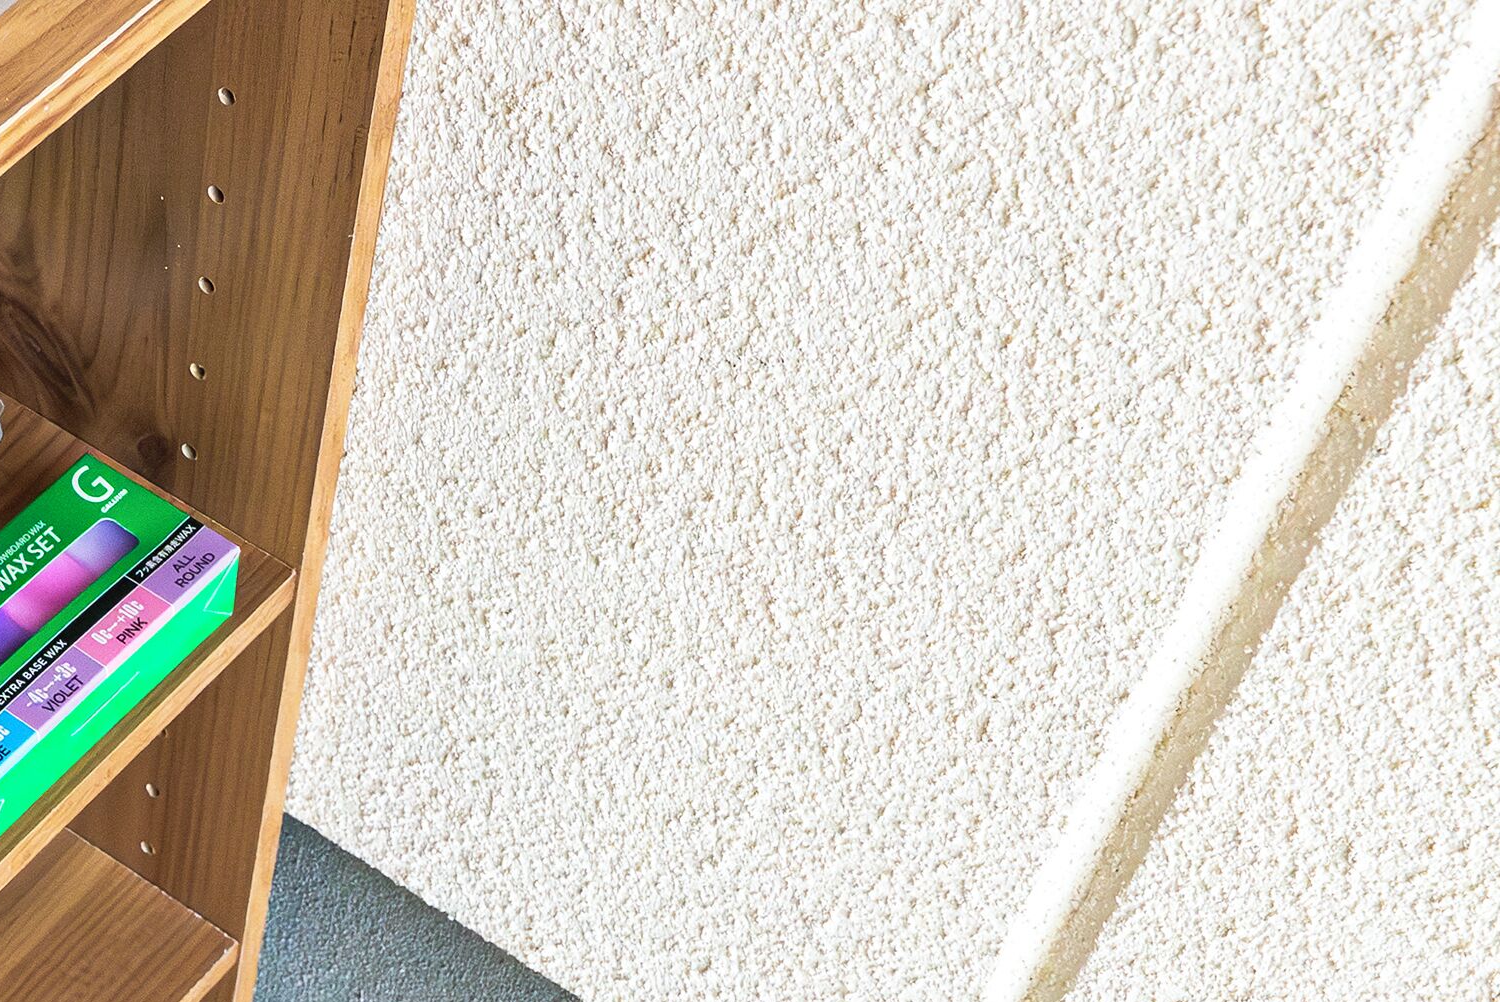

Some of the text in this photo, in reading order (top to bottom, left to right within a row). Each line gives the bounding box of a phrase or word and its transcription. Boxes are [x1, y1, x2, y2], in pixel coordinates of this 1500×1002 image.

[71, 465, 115, 503] G
[101, 488, 128, 513] GALLIUM
[27, 526, 61, 560] SET
[28, 520, 46, 537] WAX
[172, 555, 196, 573] ALL
[174, 552, 216, 588] ROUND
[116, 617, 148, 645] PINK
[24, 657, 48, 680] BASE
[44, 638, 68, 662] WAX
[41, 674, 84, 714] VIOLET
